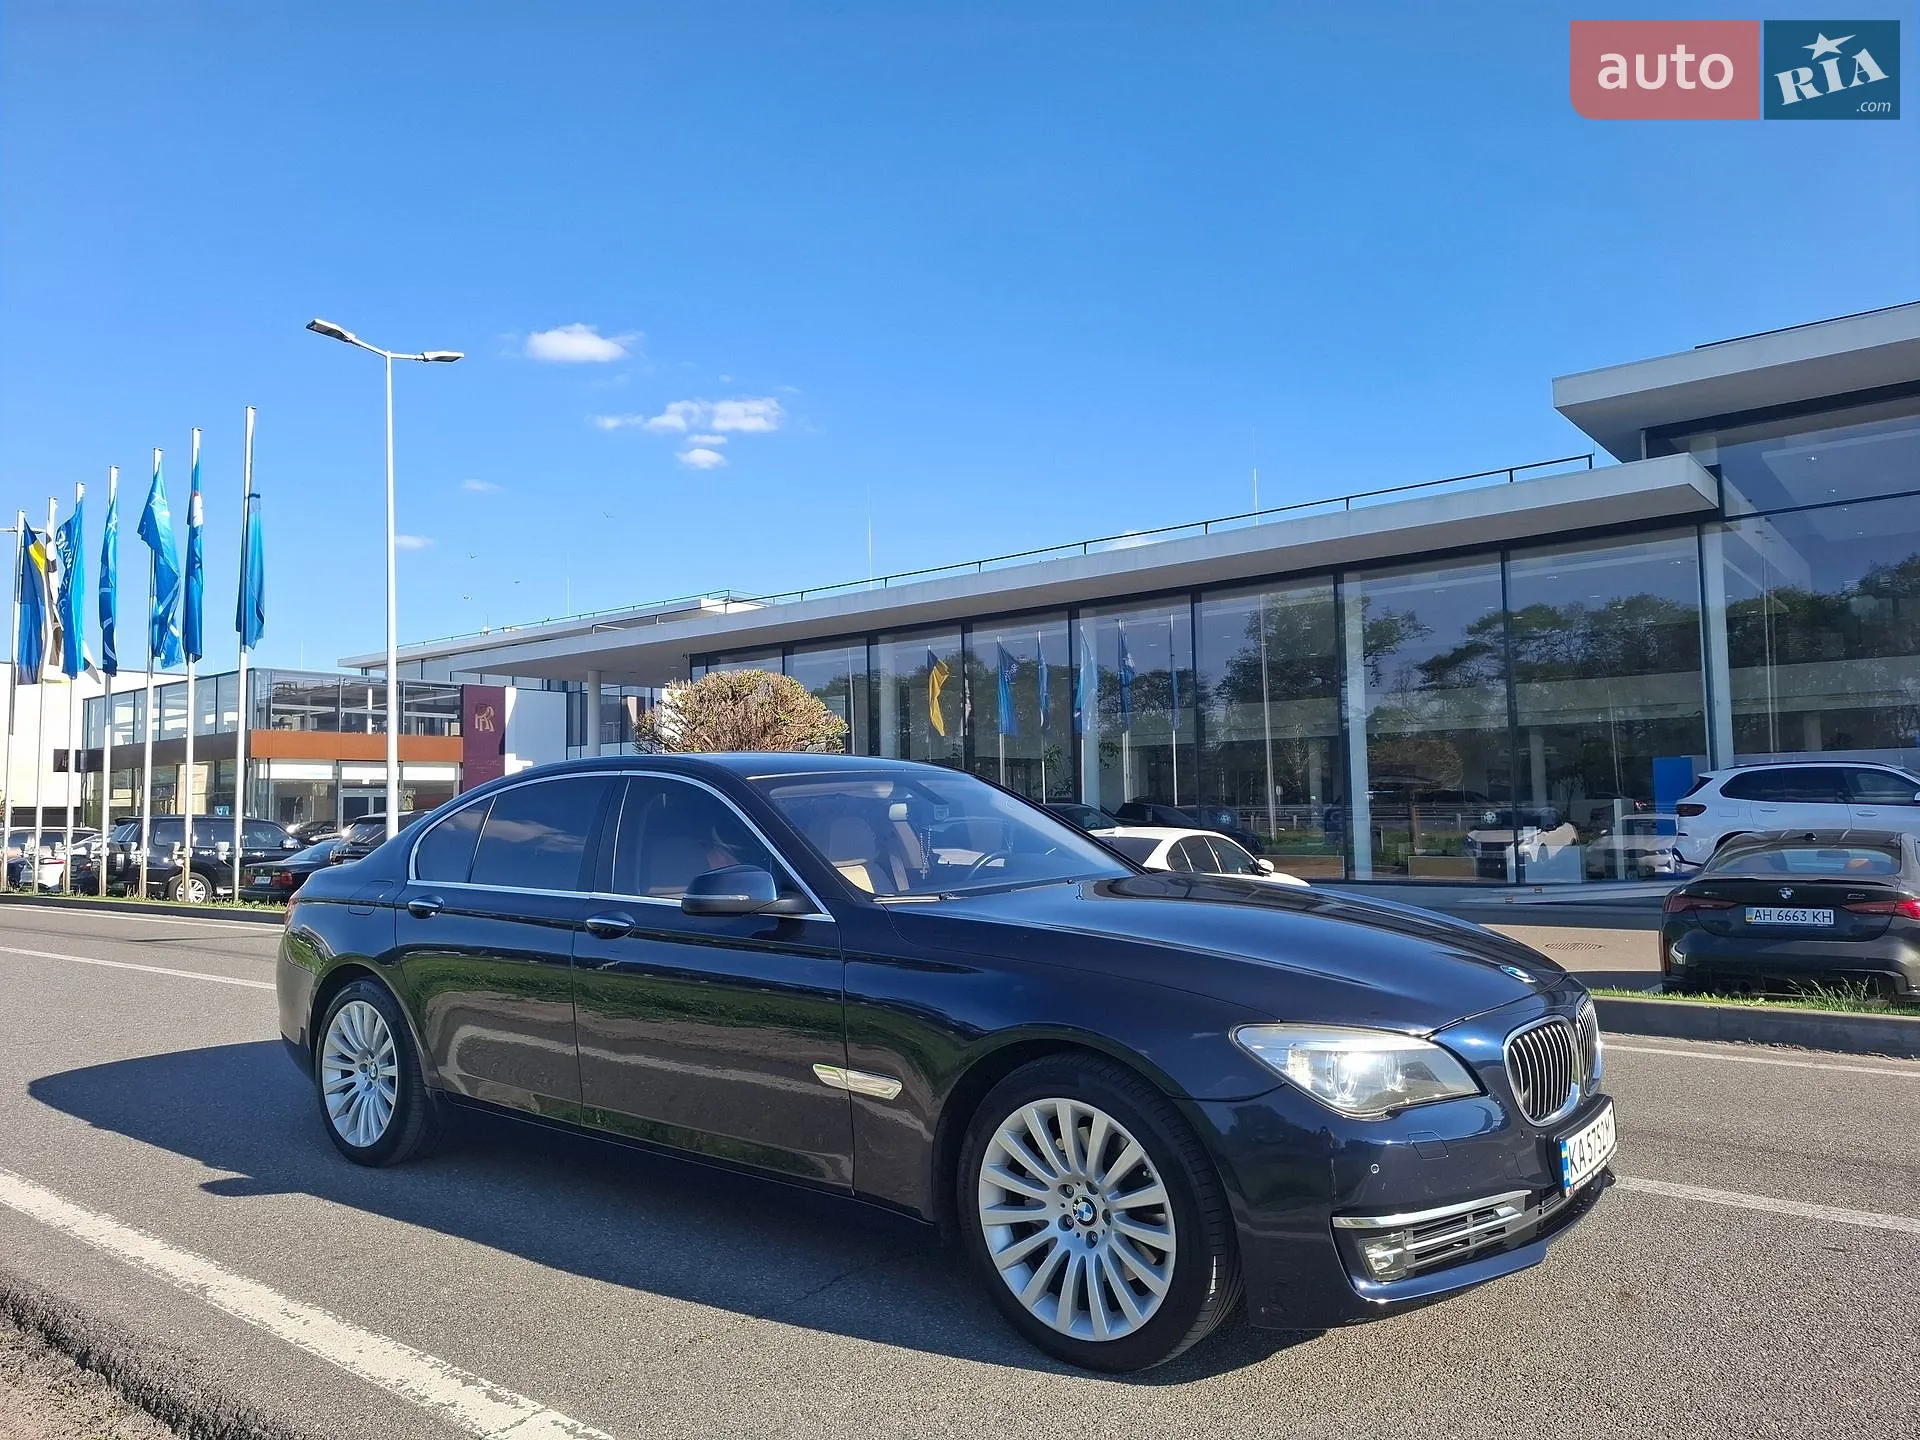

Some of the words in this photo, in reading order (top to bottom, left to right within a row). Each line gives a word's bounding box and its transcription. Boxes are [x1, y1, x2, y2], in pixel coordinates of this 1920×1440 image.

[1754, 909, 1772, 921] AH
[1776, 910, 1807, 922] 6663
[1812, 911, 1832, 923] KH
